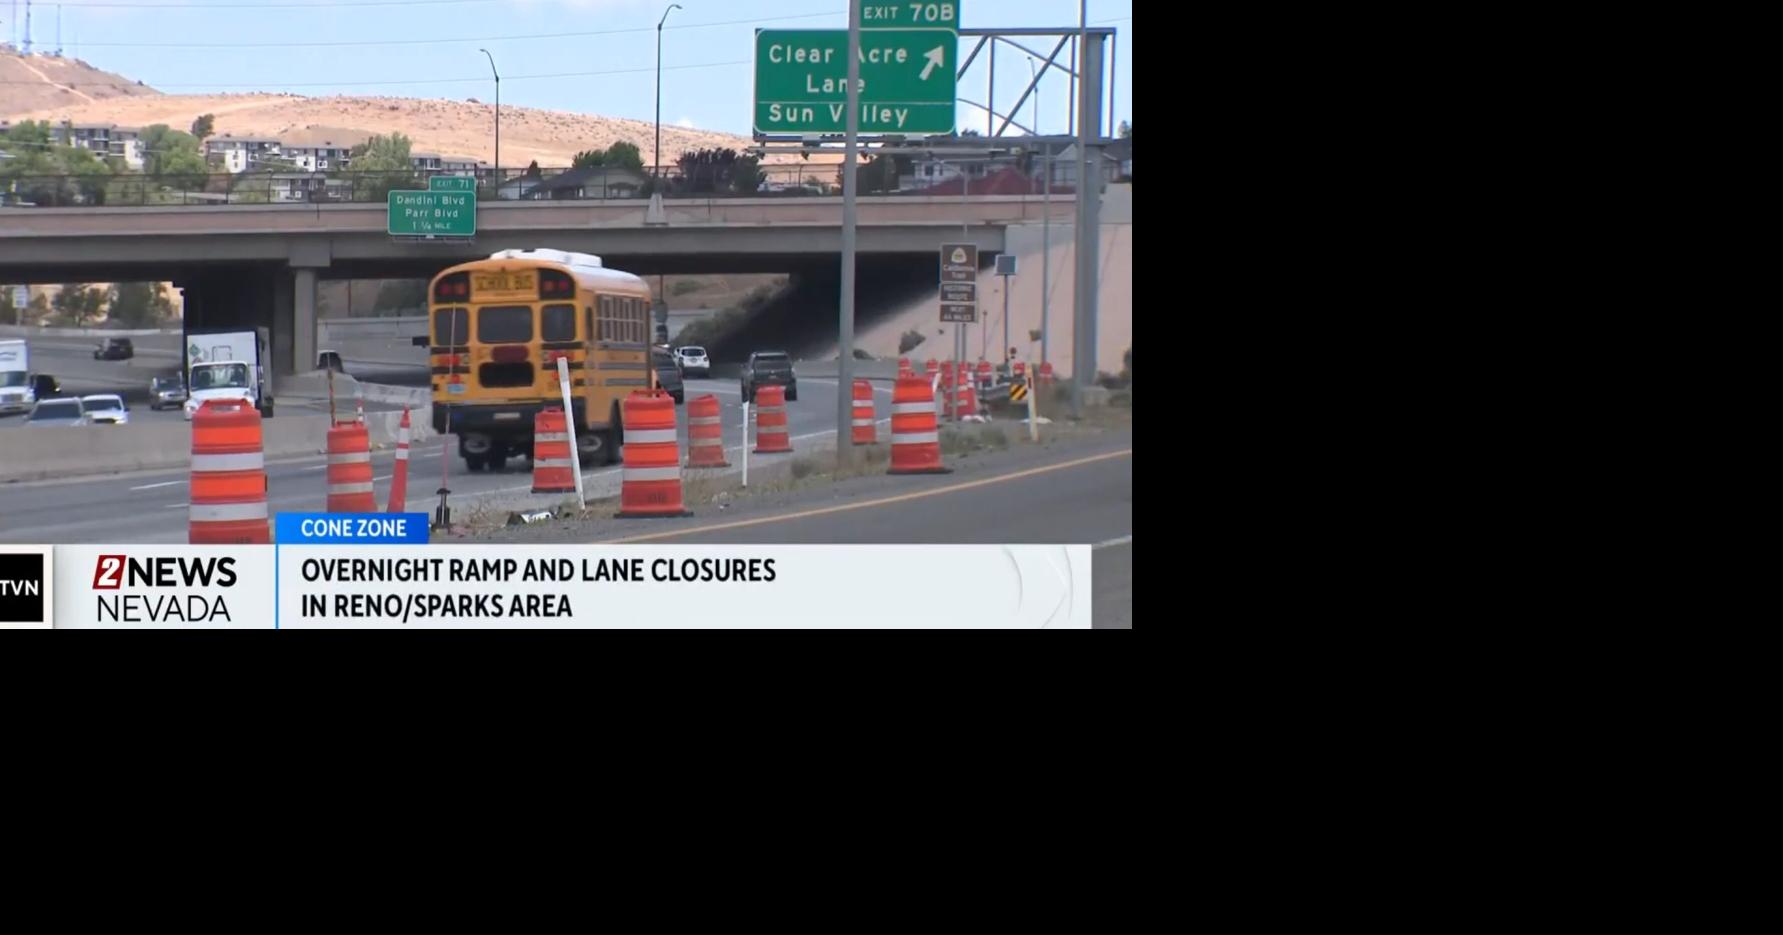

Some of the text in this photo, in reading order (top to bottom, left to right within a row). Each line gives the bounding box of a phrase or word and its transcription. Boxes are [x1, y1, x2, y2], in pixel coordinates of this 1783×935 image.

[863, 3, 954, 21] EXIT 70B
[768, 45, 834, 63] Clear
[768, 104, 908, 128] Sun Vlley
[458, 179, 469, 189] 71
[396, 195, 465, 206] Dandini Blvd
[405, 208, 458, 218] Parr Blvd
